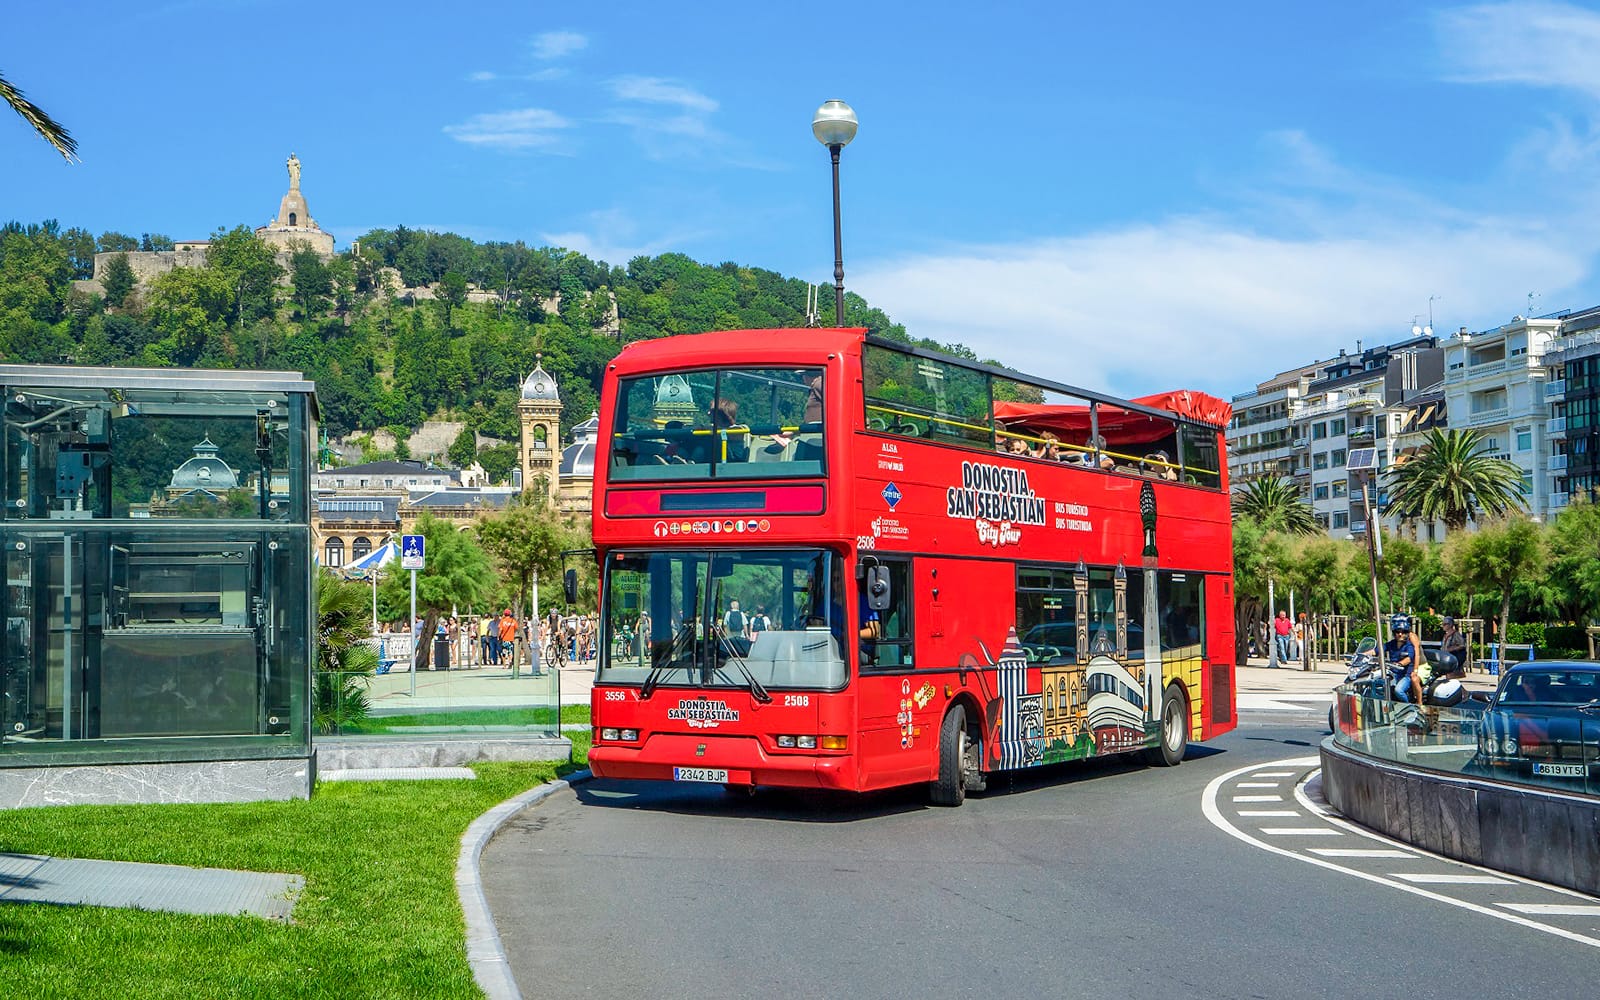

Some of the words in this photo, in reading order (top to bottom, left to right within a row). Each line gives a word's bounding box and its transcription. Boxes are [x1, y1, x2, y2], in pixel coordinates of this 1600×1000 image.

[881, 443, 898, 453] ALSA
[962, 461, 1029, 497] DONOSTIA
[948, 487, 976, 519] SAN
[977, 489, 1045, 525] SEBASTIÁN
[1055, 502, 1065, 513] BUS
[1056, 518, 1065, 529] BUS
[976, 519, 998, 547] City
[1000, 520, 1021, 545] Tour
[857, 536, 875, 550] 2508
[605, 691, 626, 701] 3556
[784, 695, 809, 706] 2508
[679, 700, 726, 711] DONOSTIA
[668, 709, 686, 719] SAN
[688, 708, 739, 721] SEBASTIÁN
[680, 769, 705, 780] 2342
[707, 770, 726, 781] BJP
[1562, 766, 1573, 774] VT
